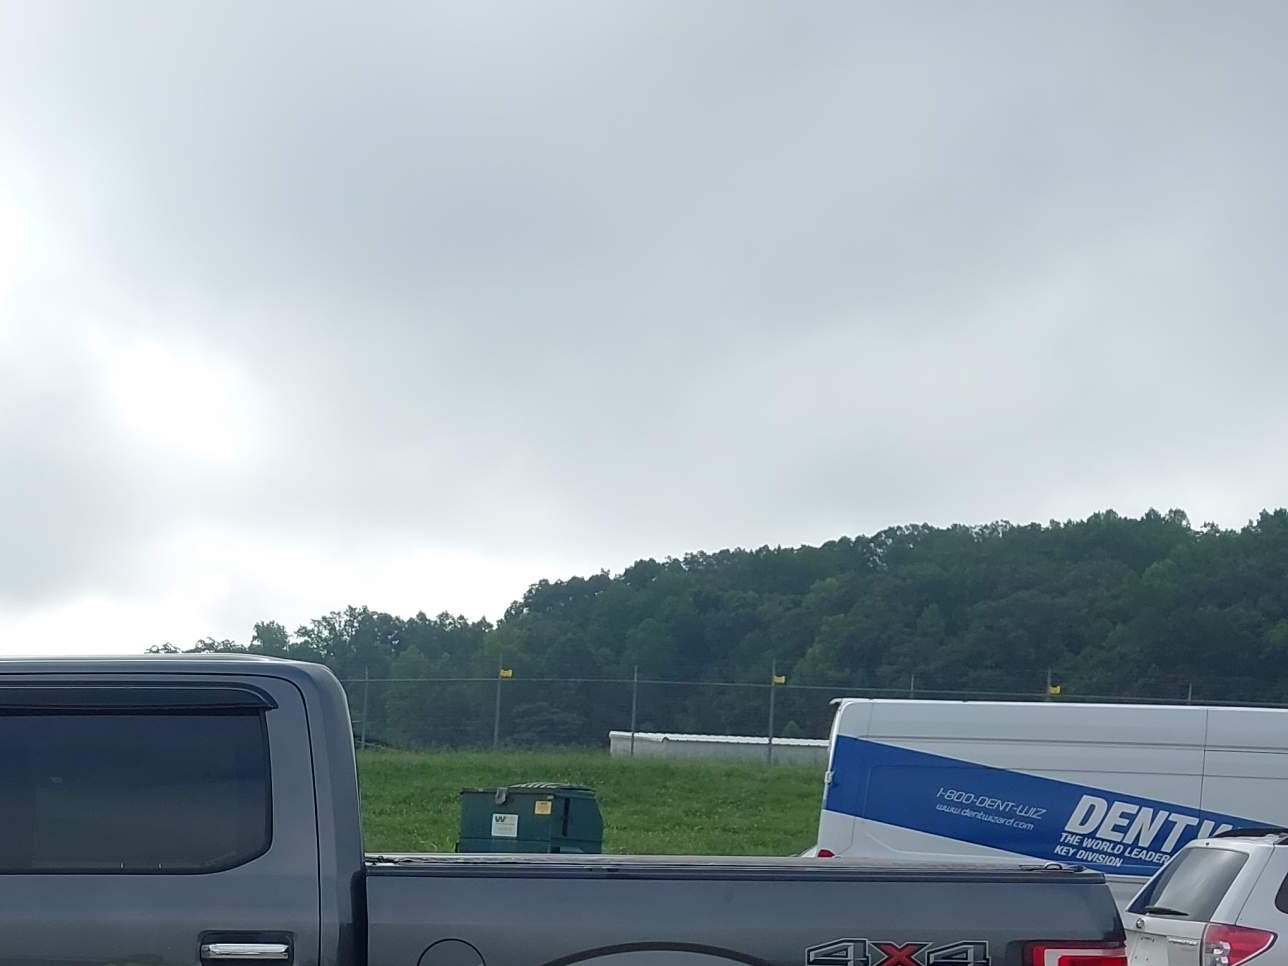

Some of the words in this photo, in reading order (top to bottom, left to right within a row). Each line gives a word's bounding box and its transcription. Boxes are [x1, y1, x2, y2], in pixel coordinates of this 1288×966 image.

[936, 787, 1047, 819] 1-800-DENT-WIZ
[1059, 833, 1081, 846] THE
[1083, 837, 1123, 854] WORLD
[1054, 845, 1075, 857] KEY
[1077, 850, 1123, 867] DIVISION
